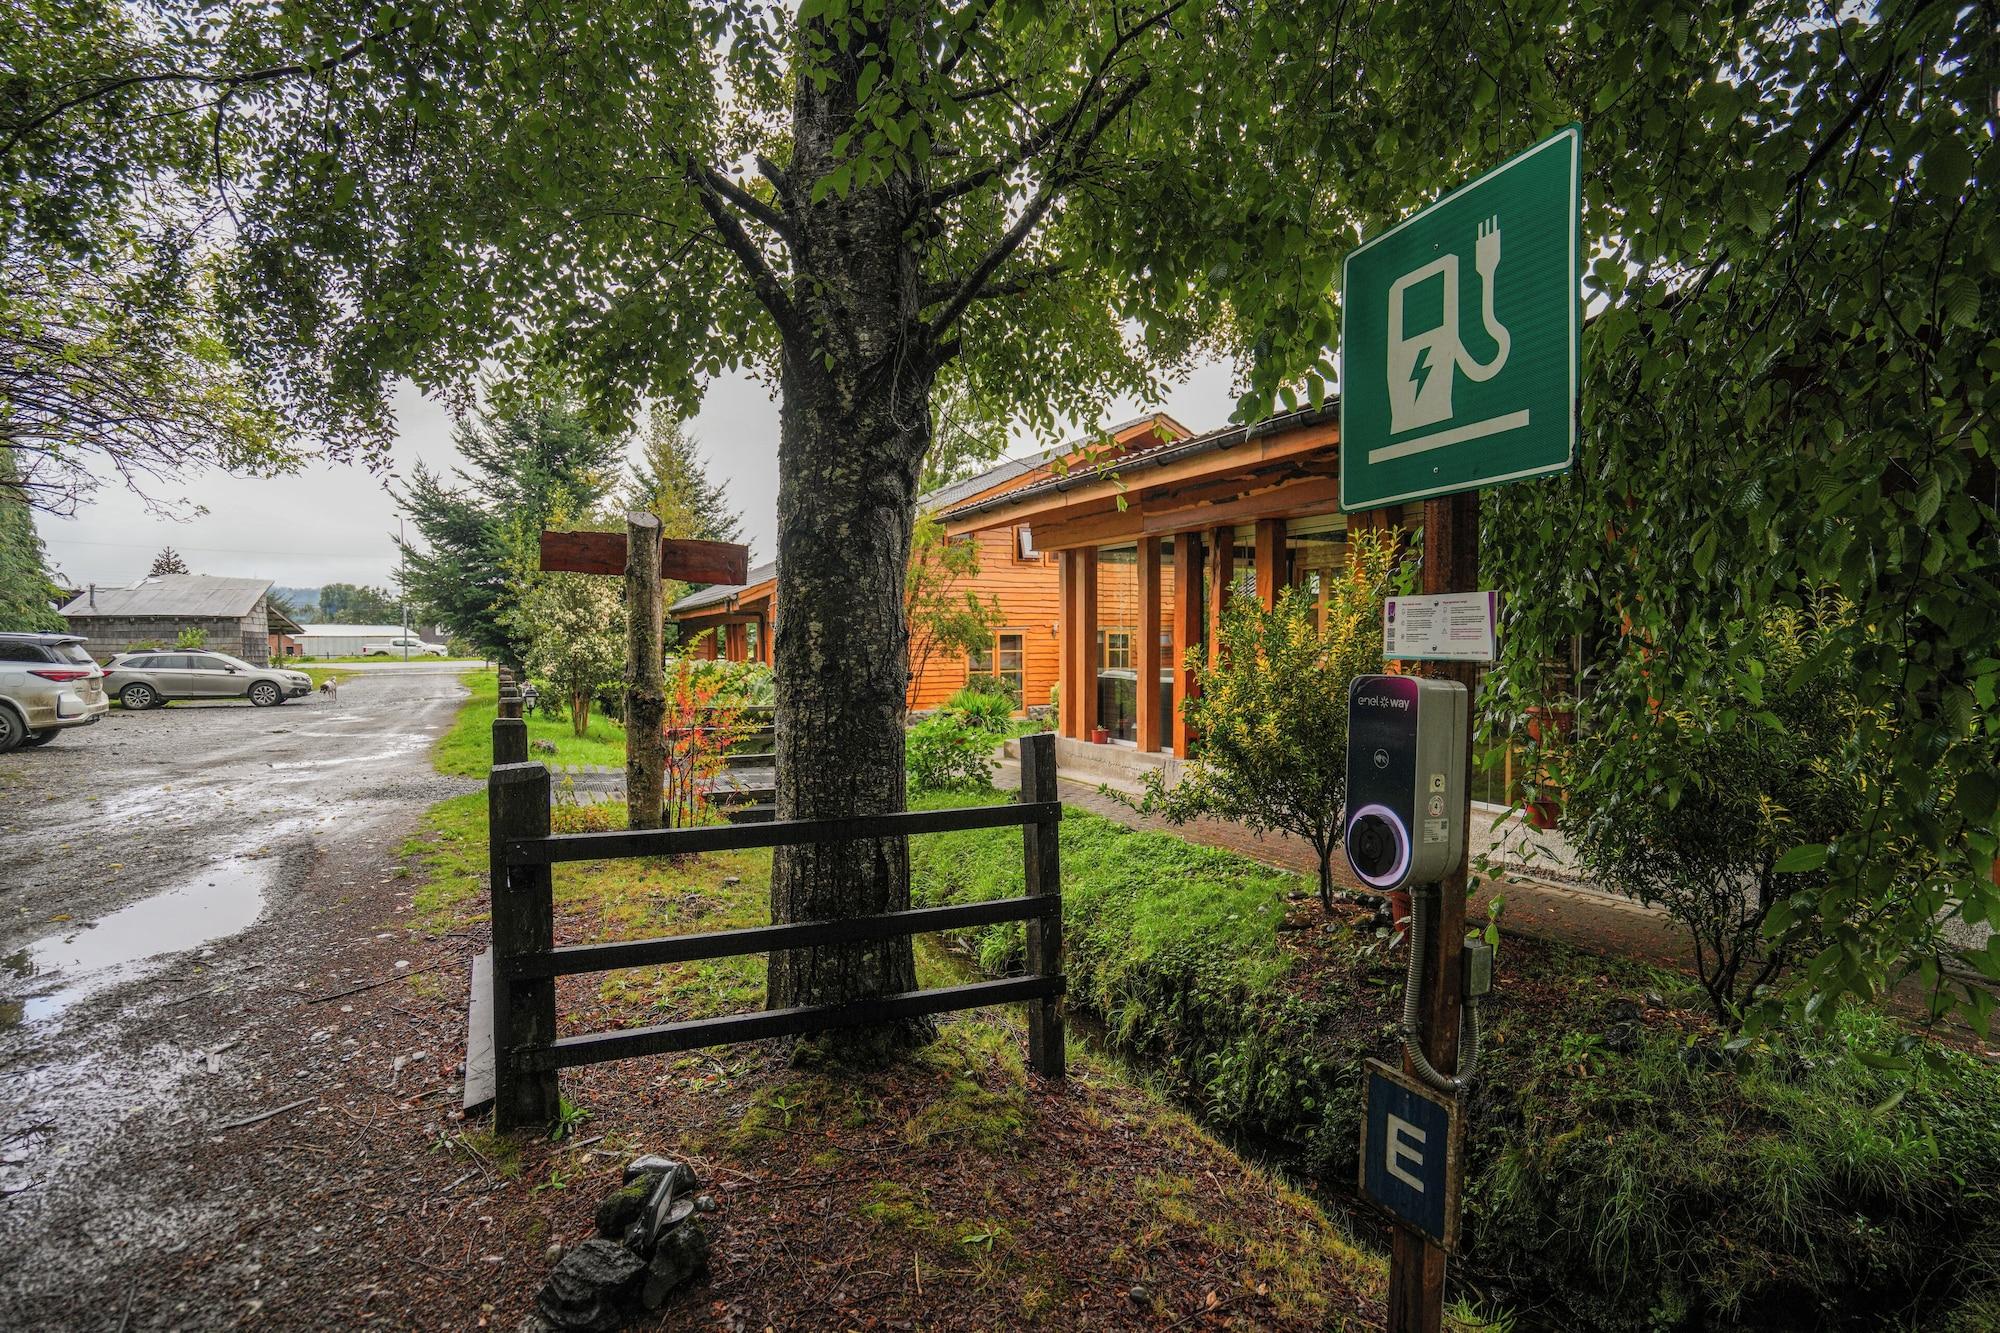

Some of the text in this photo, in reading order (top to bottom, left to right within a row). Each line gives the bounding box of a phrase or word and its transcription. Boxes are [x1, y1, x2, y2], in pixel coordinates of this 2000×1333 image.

[1358, 695, 1410, 711] enel way
[1435, 778, 1441, 788] C
[1386, 1113, 1426, 1193] E
